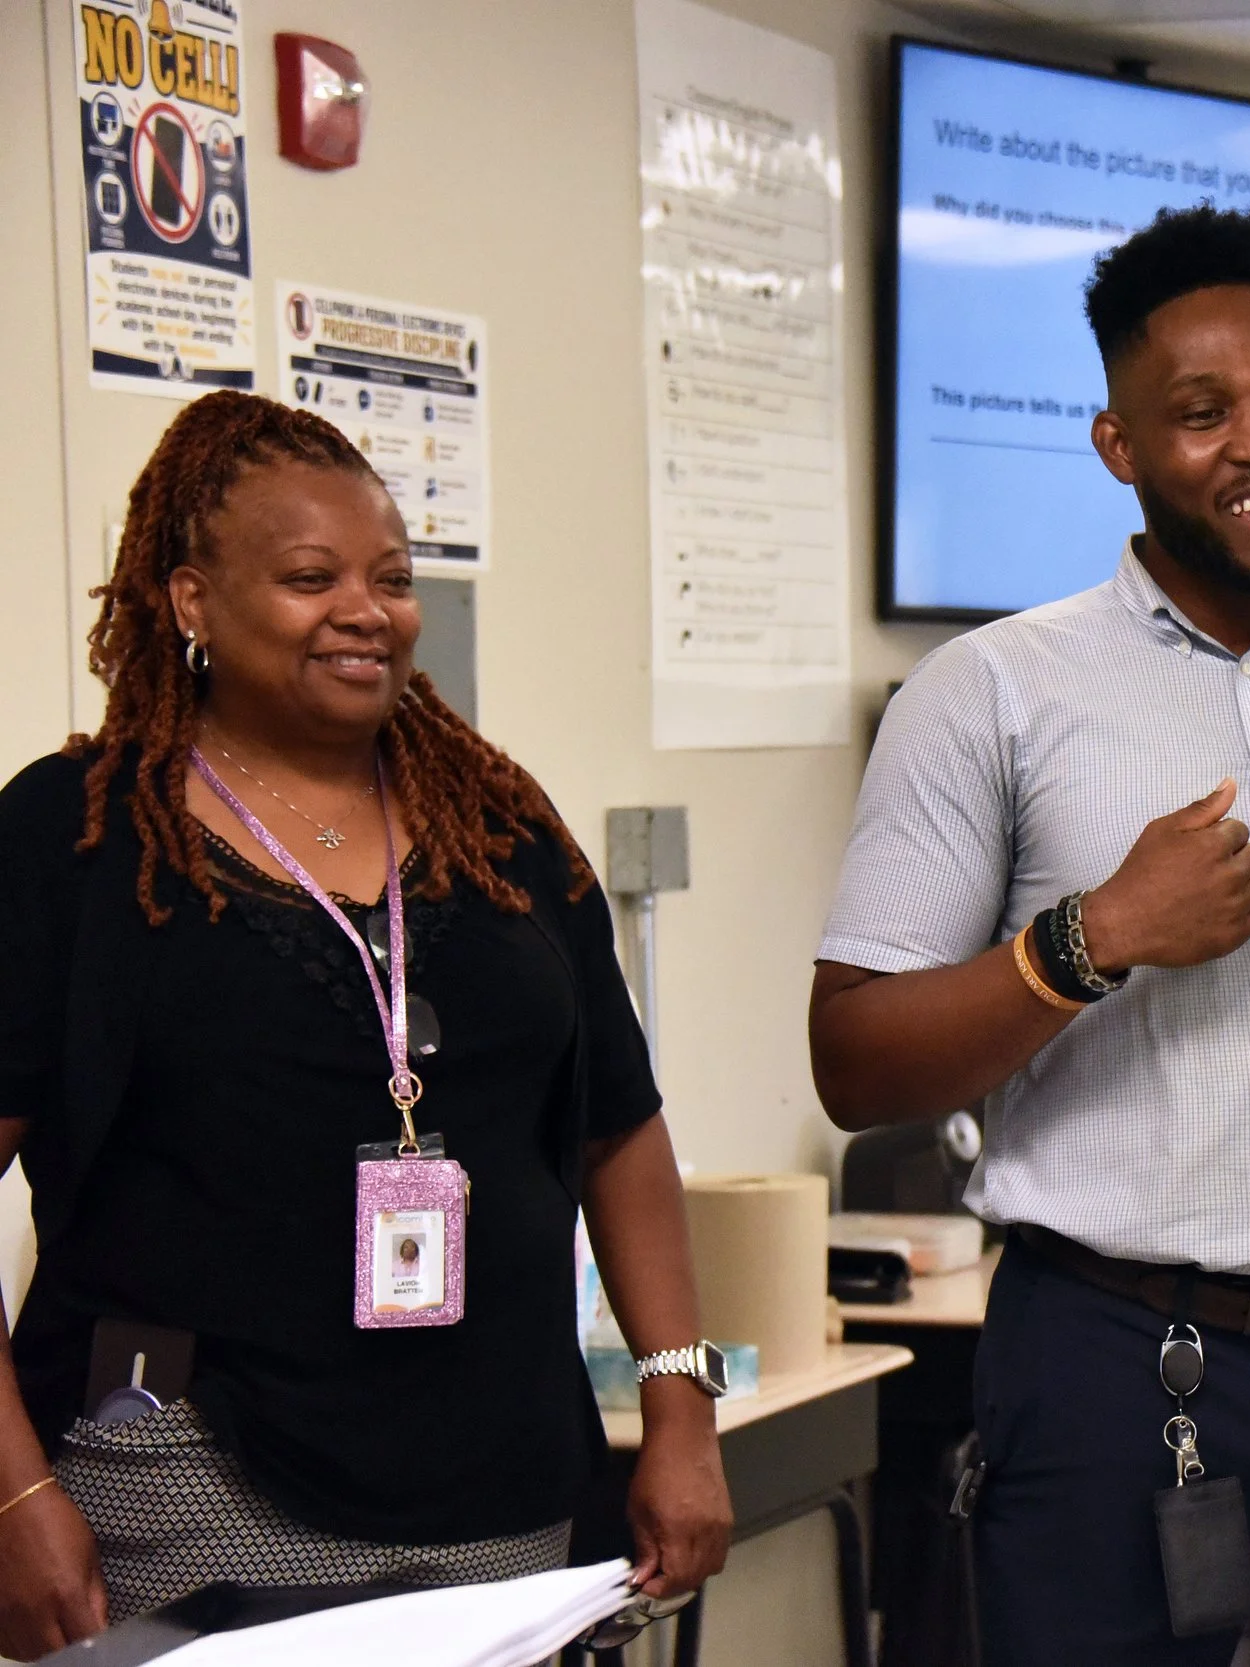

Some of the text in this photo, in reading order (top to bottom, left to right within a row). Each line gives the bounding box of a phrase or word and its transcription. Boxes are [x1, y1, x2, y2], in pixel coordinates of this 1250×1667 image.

[81, 4, 240, 118] NO CELL!
[933, 118, 993, 153] Write
[1000, 129, 1061, 165] about
[1067, 141, 1100, 170] the
[1105, 149, 1176, 180] picture
[1181, 158, 1219, 189] that
[933, 193, 969, 216] Why
[975, 201, 1000, 220] did
[1003, 208, 1034, 224] you
[1038, 211, 1093, 232] choose
[321, 317, 461, 361] PROGRESSIVE DISCIPLINE
[932, 384, 965, 408] This
[969, 393, 1025, 413] picture
[1030, 397, 1062, 417] tells
[1066, 405, 1085, 418] us
